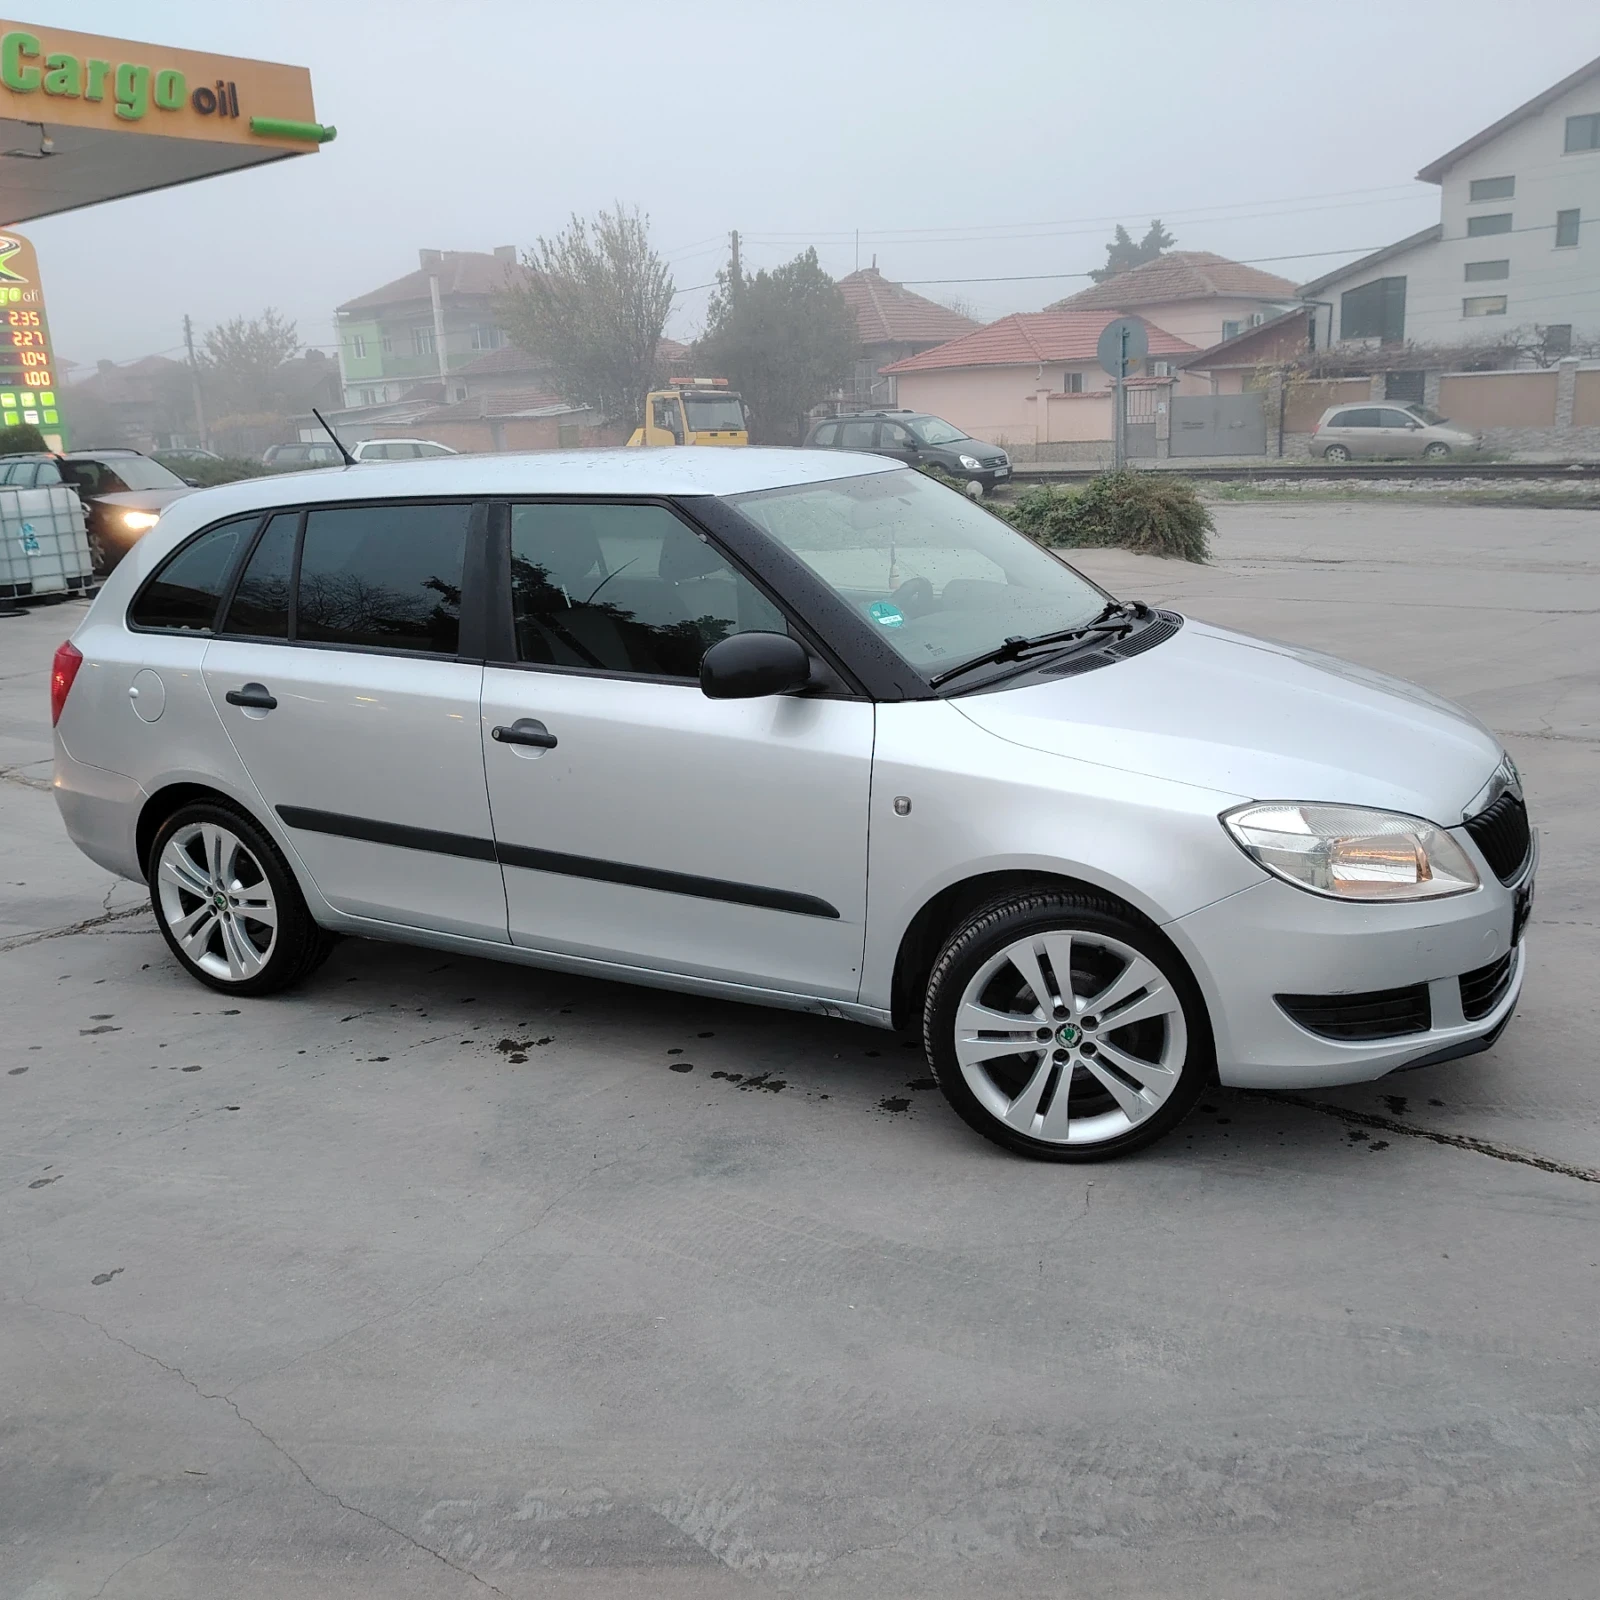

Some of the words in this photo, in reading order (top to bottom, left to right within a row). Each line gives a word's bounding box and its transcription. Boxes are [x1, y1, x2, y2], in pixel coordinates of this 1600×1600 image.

[1, 31, 188, 120] Cargo
[192, 80, 240, 118] oil
[9, 311, 40, 326] 2.35
[13, 331, 44, 346] 2.27
